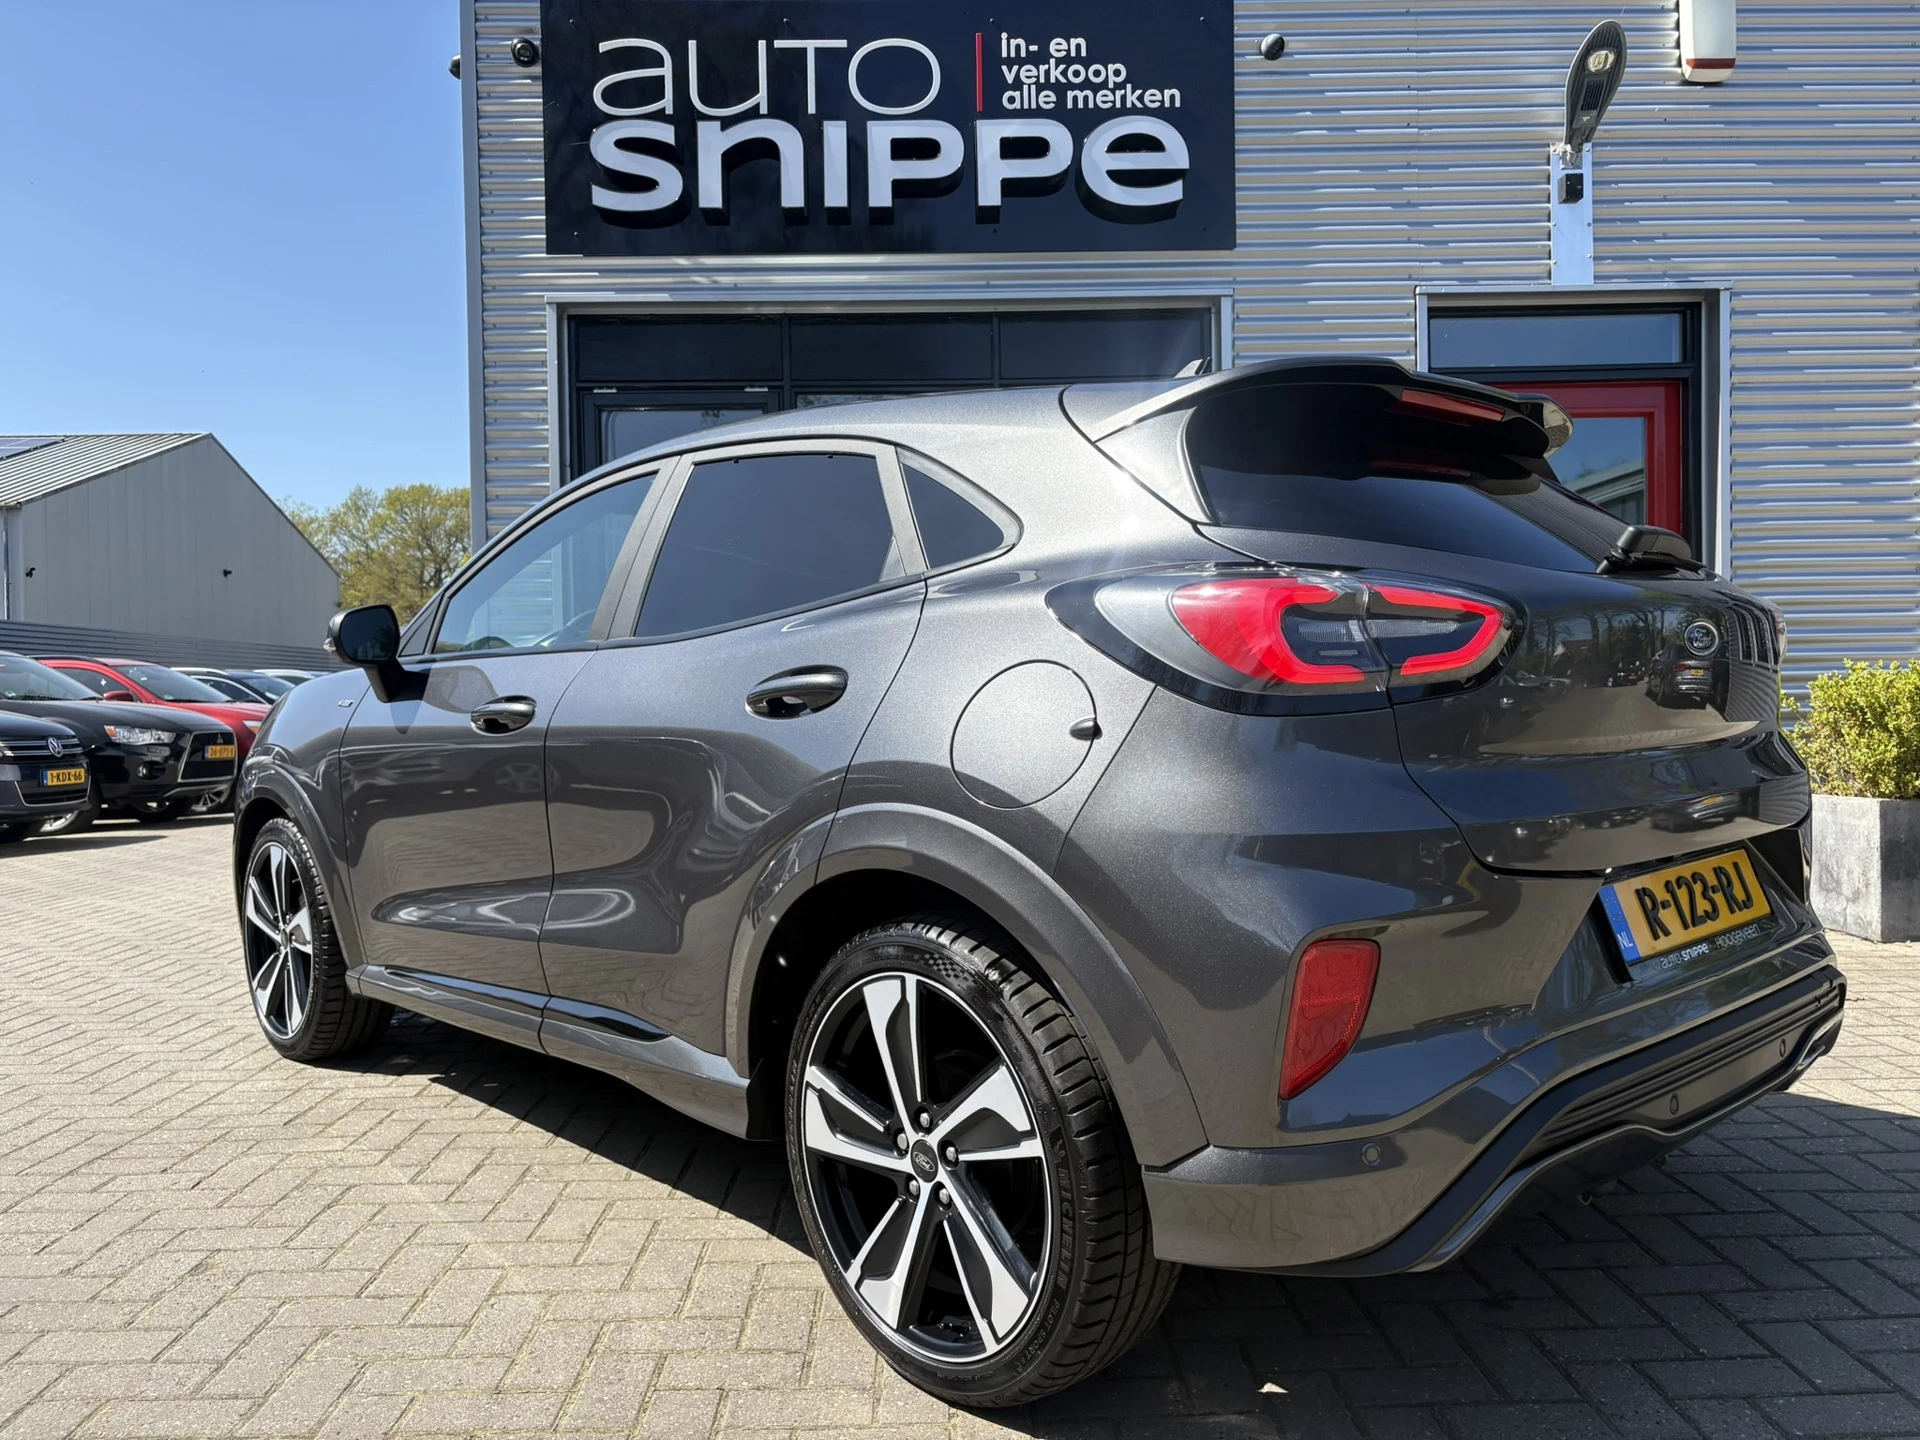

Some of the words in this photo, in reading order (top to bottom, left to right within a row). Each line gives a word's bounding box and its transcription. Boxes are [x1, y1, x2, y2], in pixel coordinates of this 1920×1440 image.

[1000, 32, 1039, 58] in-
[1049, 38, 1087, 58] en
[1001, 58, 1127, 88] verkoop
[1001, 84, 1057, 110] alle
[1066, 84, 1181, 109] merken
[50, 770, 83, 783] 1-KDX-66
[1634, 860, 1755, 941] R-123-RJ
[1617, 933, 1634, 950] NL
[1056, 1167, 1074, 1291] MICHELIN
[1044, 1299, 1061, 1332] PILOT
[1024, 1329, 1047, 1360] SPORT
